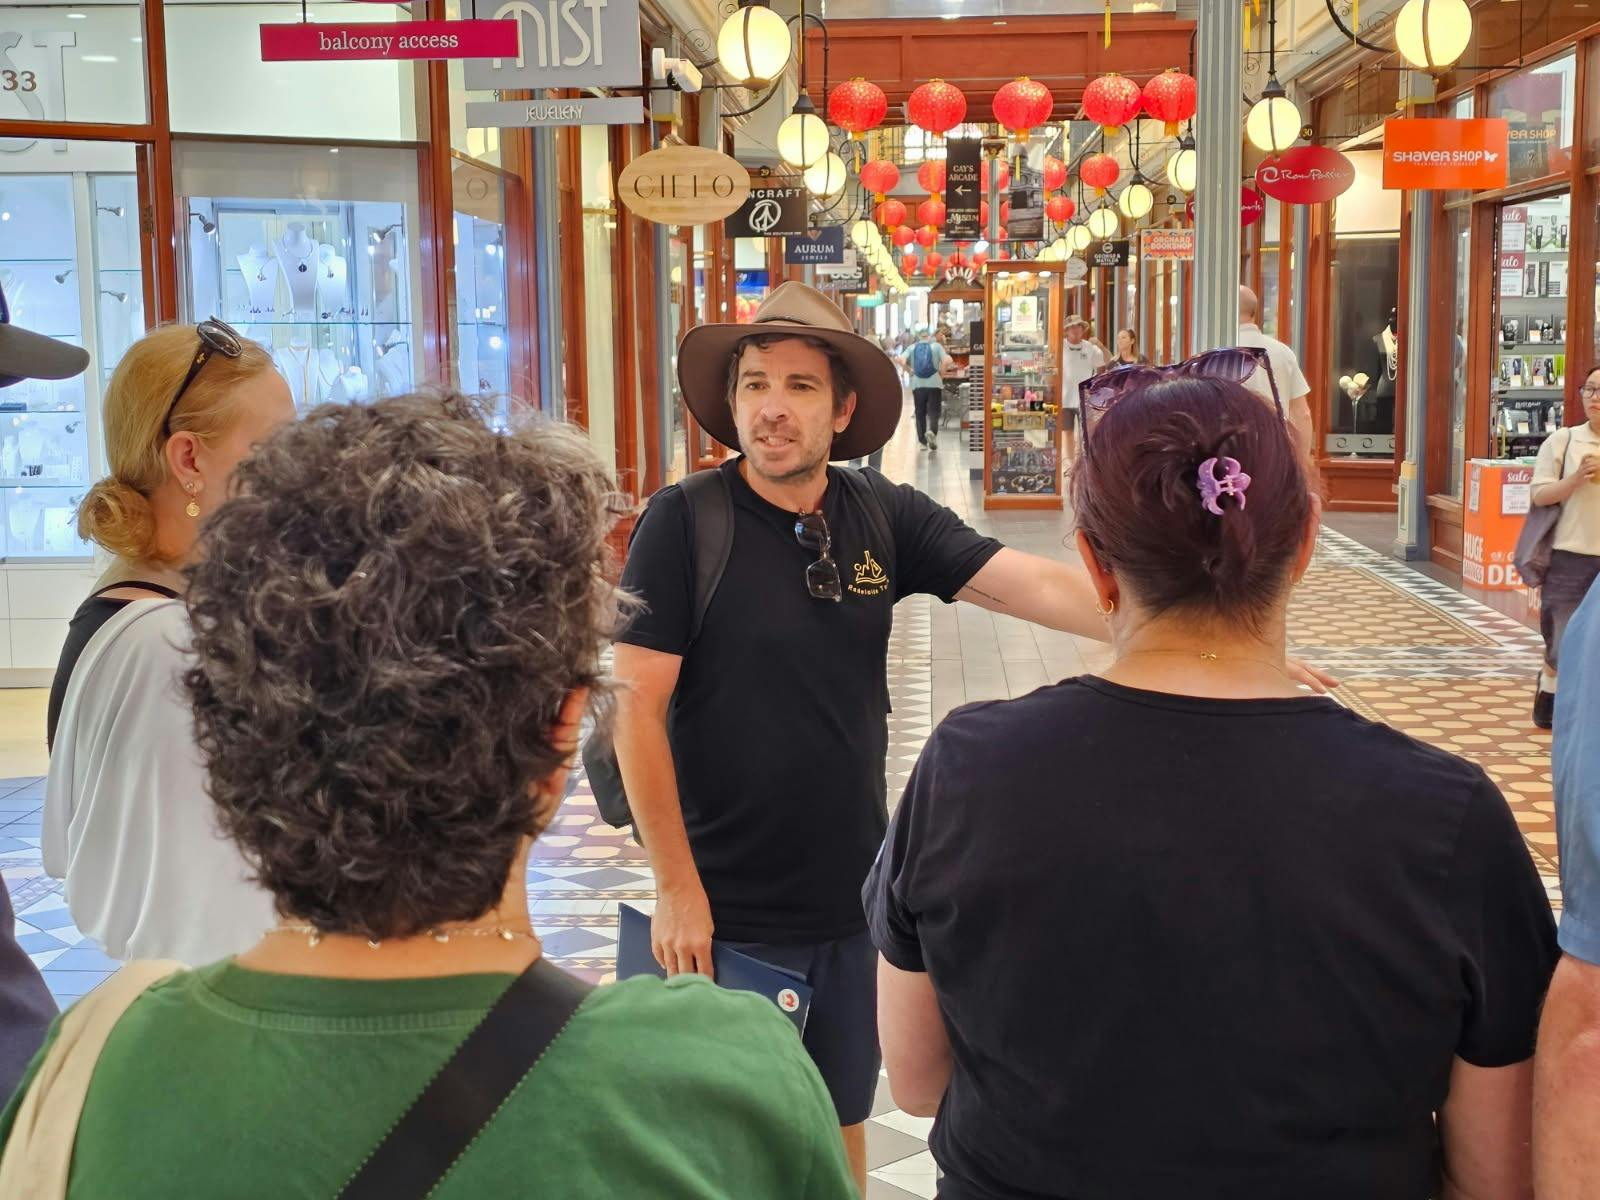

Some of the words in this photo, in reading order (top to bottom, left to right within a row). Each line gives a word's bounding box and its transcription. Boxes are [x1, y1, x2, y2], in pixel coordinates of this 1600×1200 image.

[318, 31, 394, 56] balcony
[398, 34, 459, 49] access
[525, 104, 584, 122] JEWELLERY
[1452, 150, 1483, 162] SHOP
[953, 165, 974, 173] GAY'S
[948, 174, 979, 182] ARCADE
[633, 174, 735, 199] CIELO
[794, 244, 835, 254] AURUM
[1150, 242, 1193, 250] BOOKSHOP
[1507, 470, 1529, 483] sale
[1464, 531, 1484, 562] HUGE
